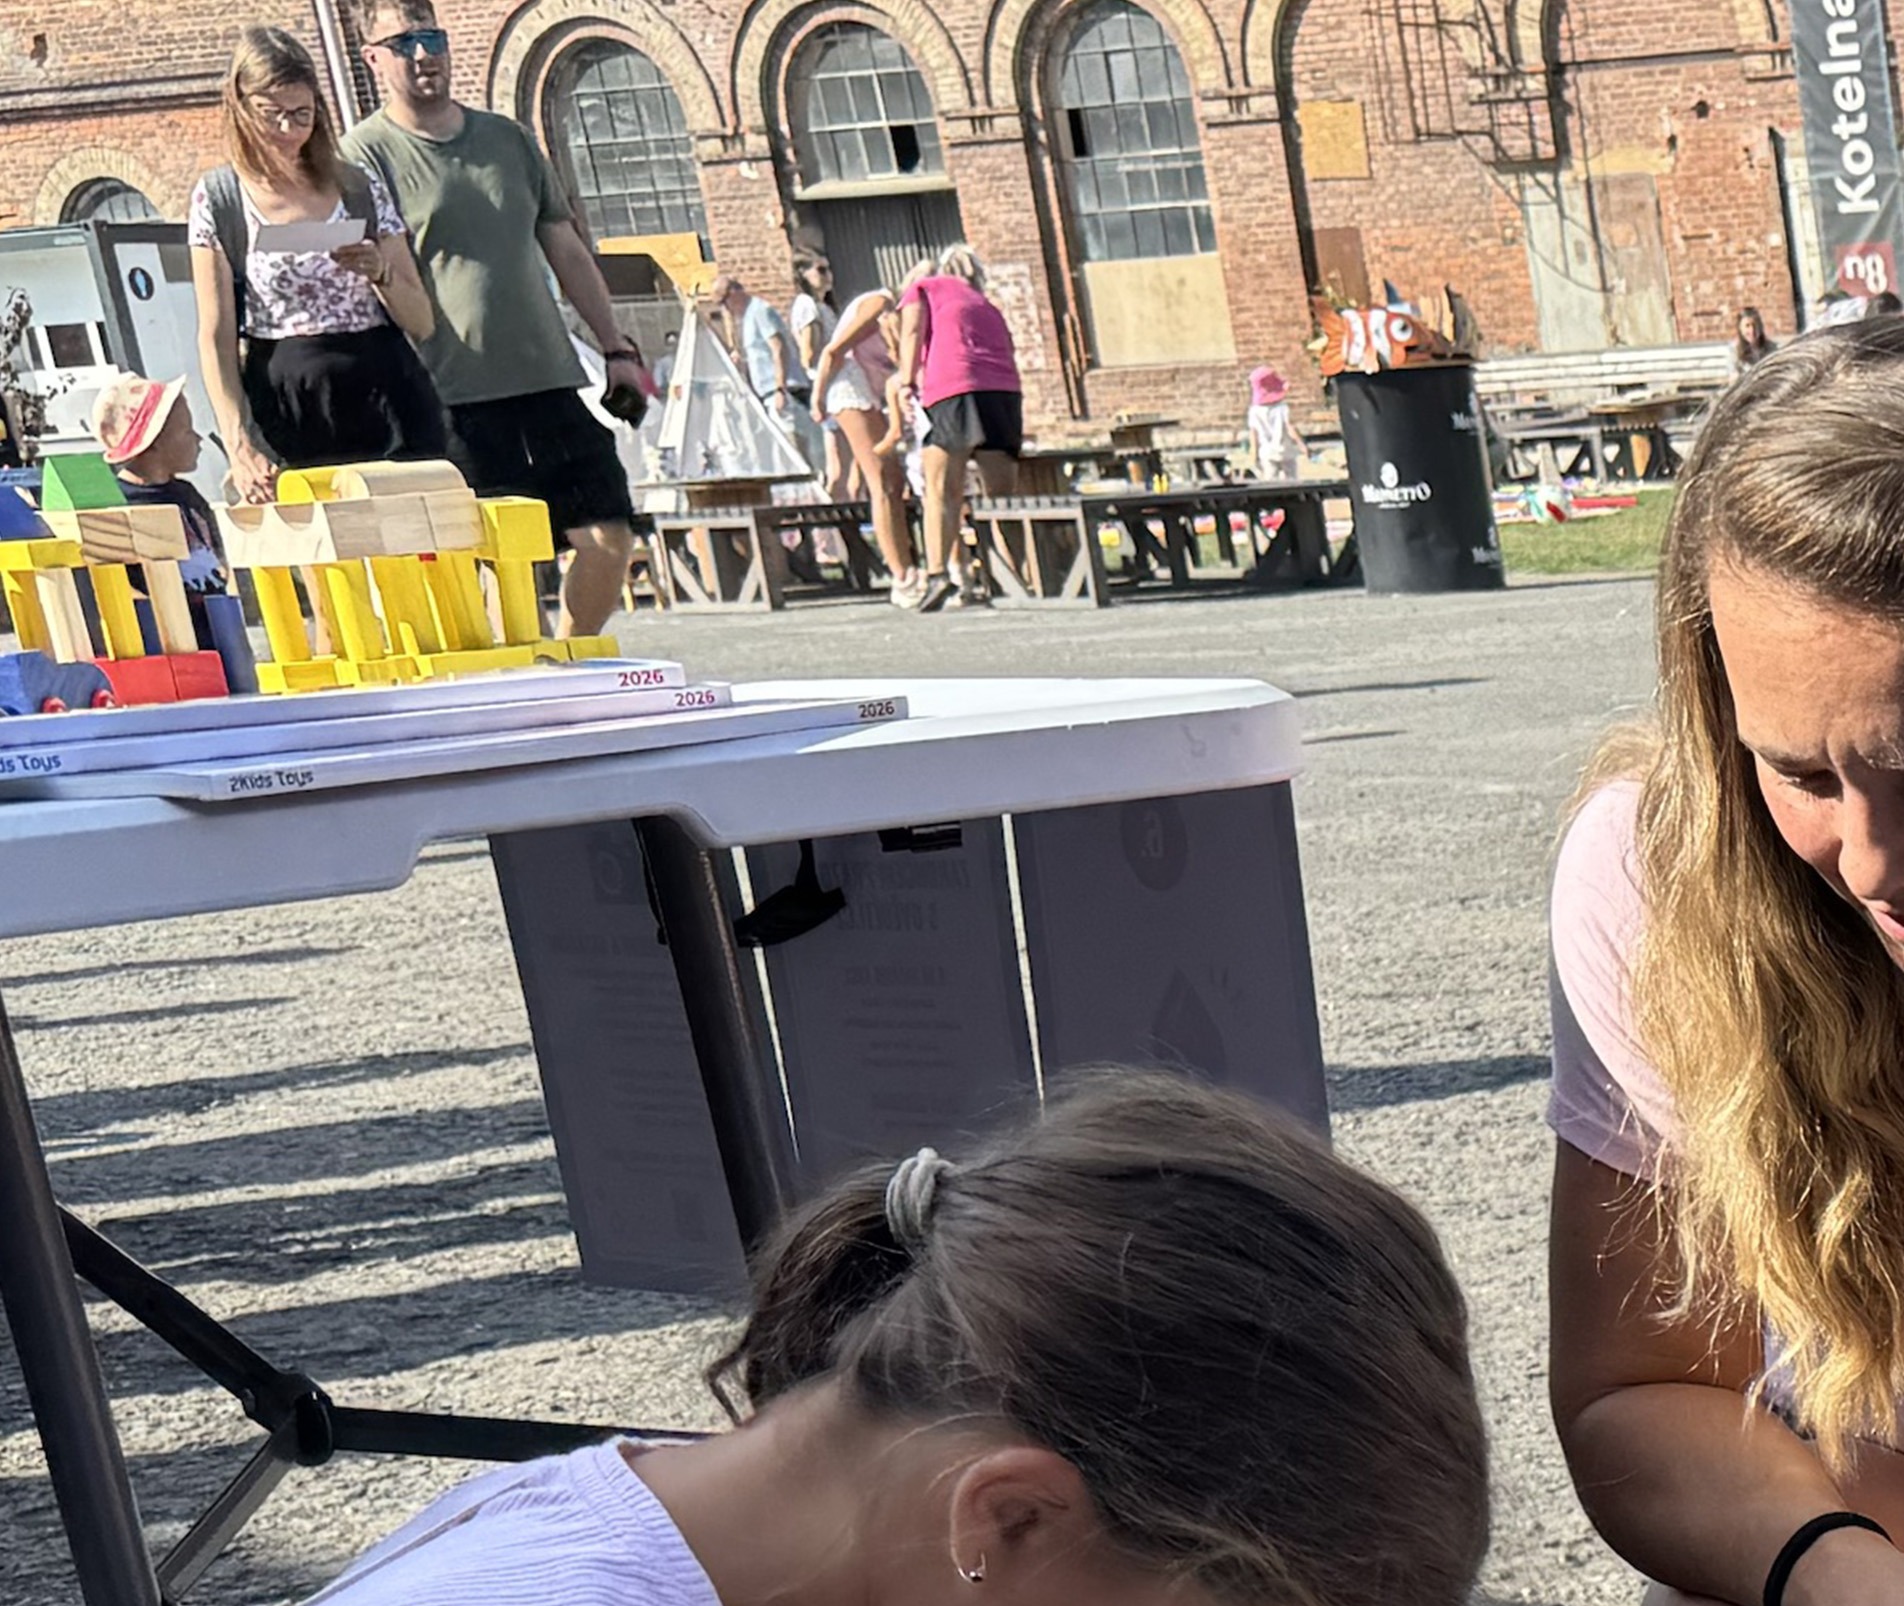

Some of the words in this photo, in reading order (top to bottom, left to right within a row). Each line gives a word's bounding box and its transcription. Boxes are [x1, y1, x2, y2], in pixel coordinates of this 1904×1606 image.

[618, 669, 664, 687] 2026
[675, 690, 715, 707] 2026
[858, 700, 895, 718] 2026
[19, 754, 62, 773] Toys
[276, 770, 315, 787] Toys
